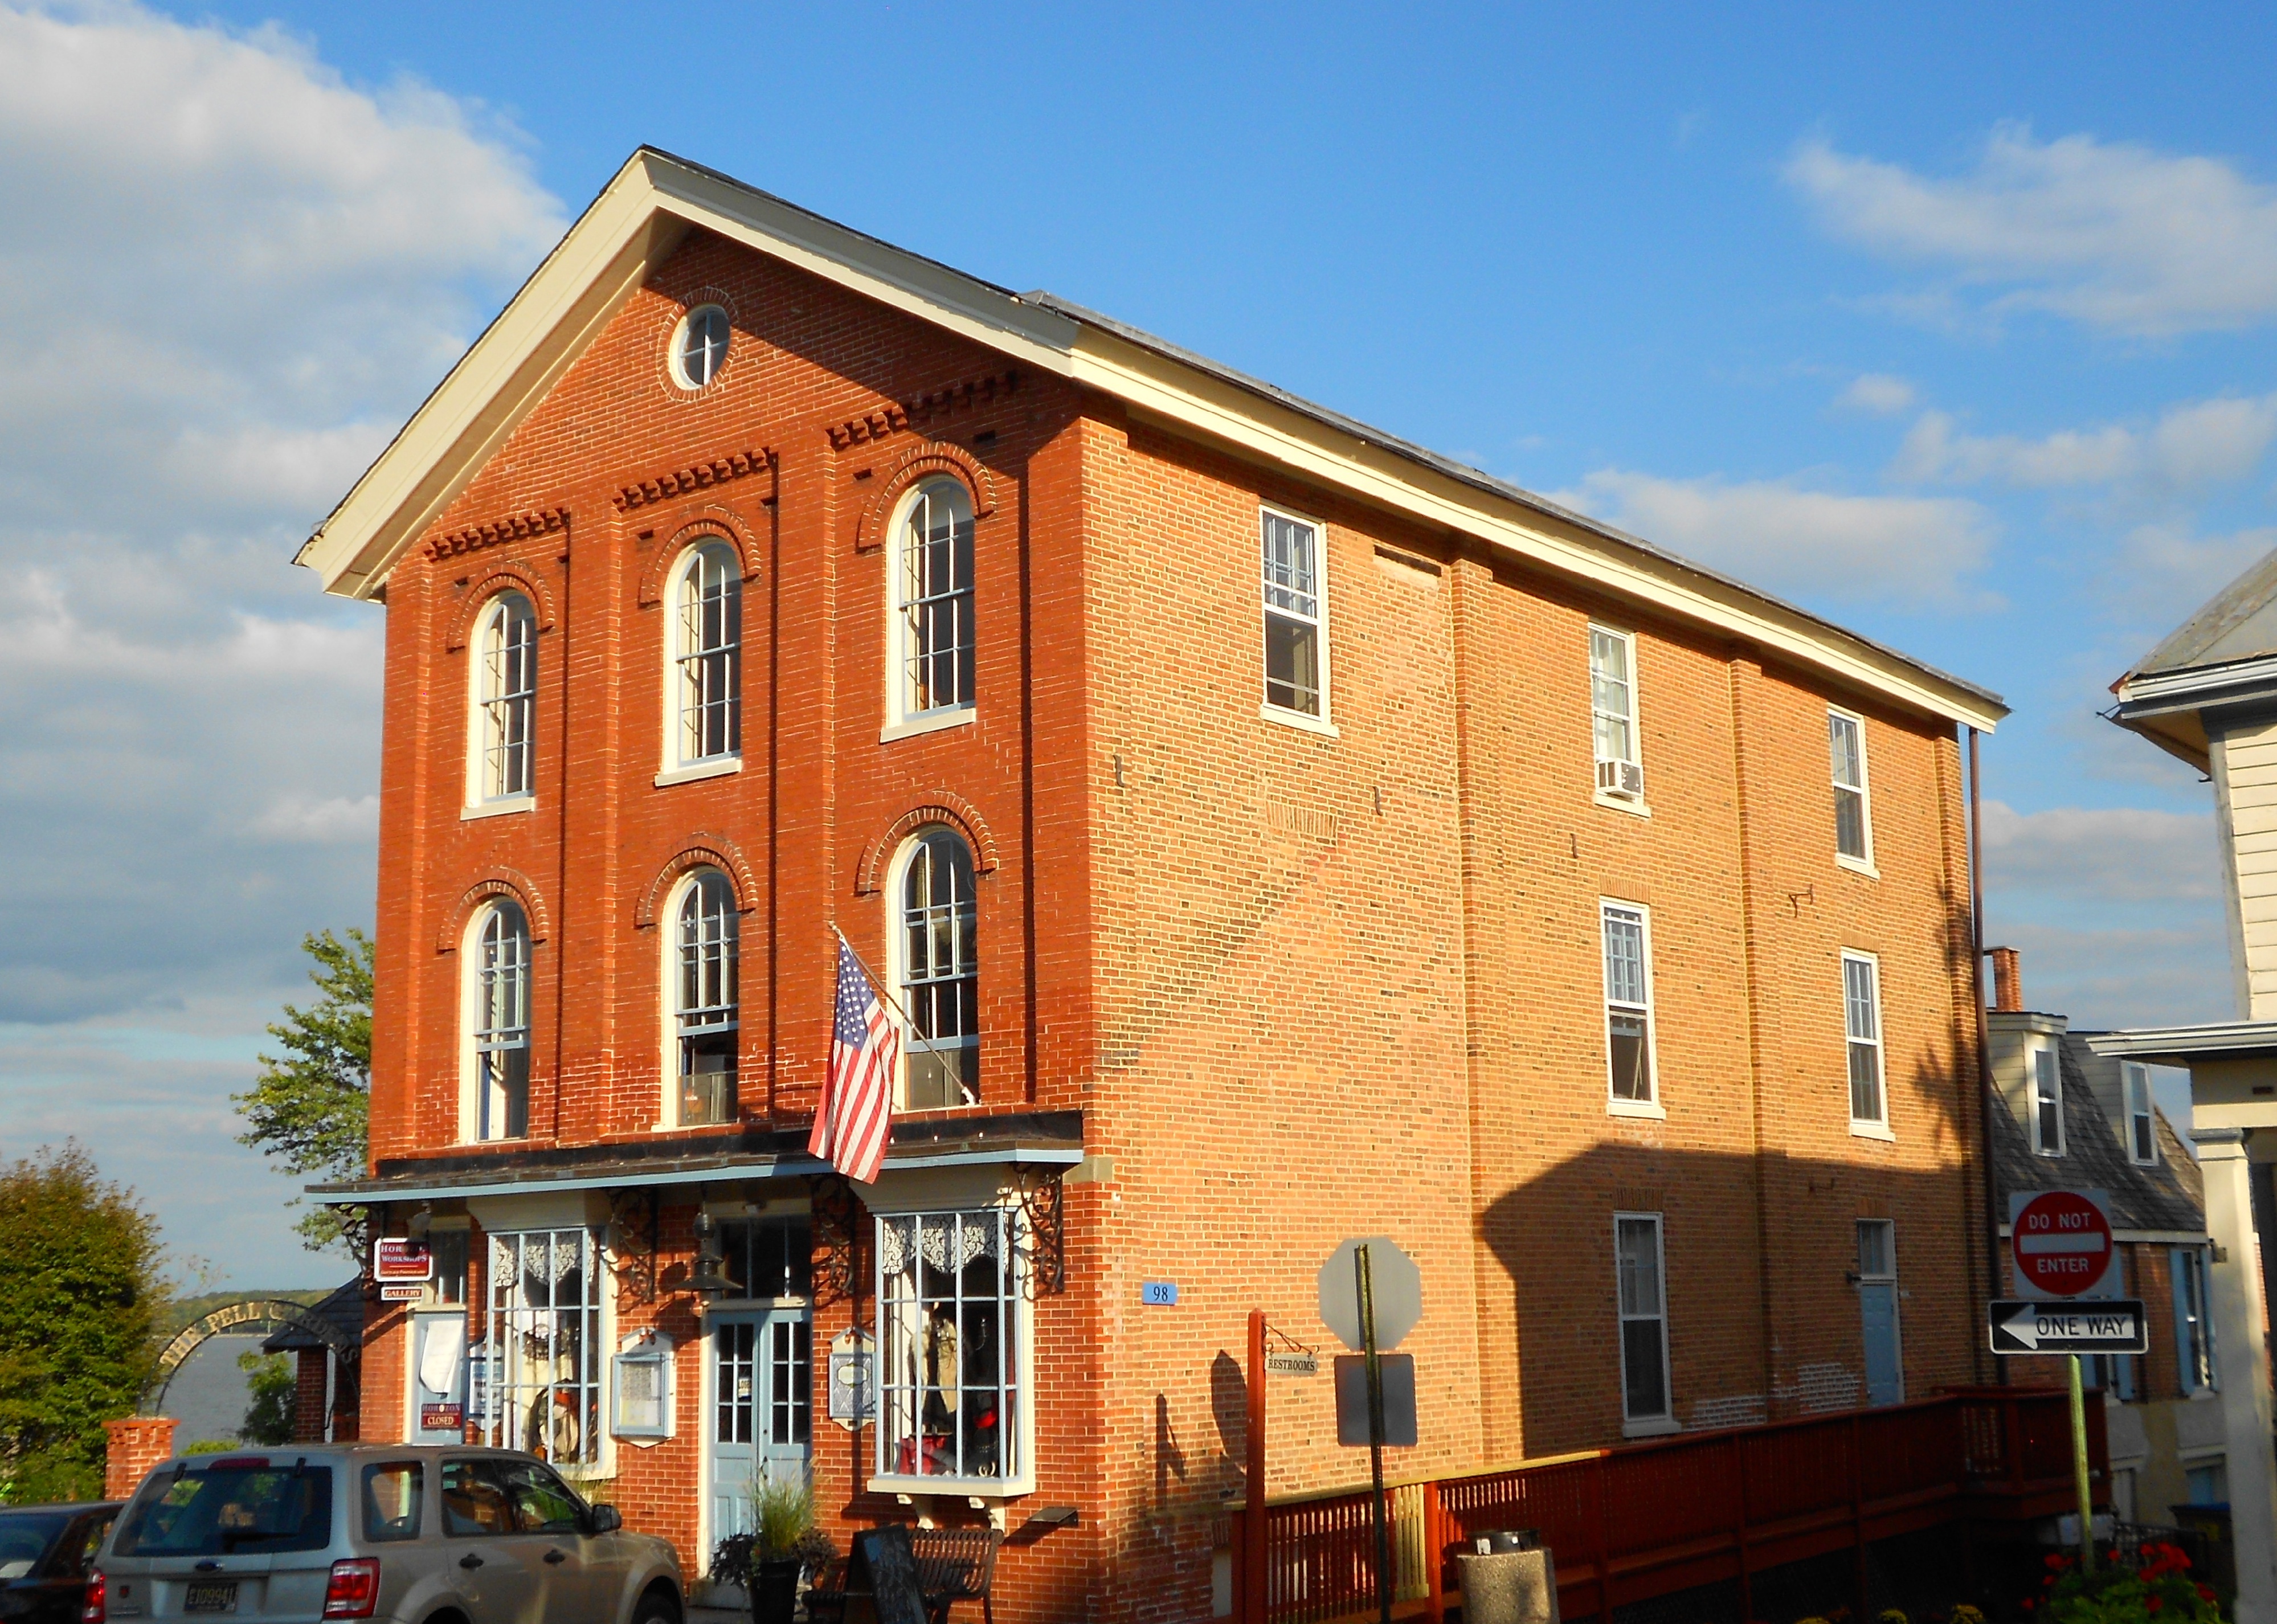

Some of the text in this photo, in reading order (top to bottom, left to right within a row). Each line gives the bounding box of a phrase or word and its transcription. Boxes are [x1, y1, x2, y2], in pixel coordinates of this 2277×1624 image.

[2029, 1213, 2090, 1229] DO NOT
[2037, 1258, 2089, 1273] ENTER
[1153, 1286, 1168, 1302] 98
[159, 1324, 201, 1367] THE
[205, 1302, 260, 1332] PELL
[2036, 1317, 2127, 1336] ONE WAY
[1268, 1359, 1315, 1371] RESTROOMS
[427, 1416, 454, 1425] CLOSED
